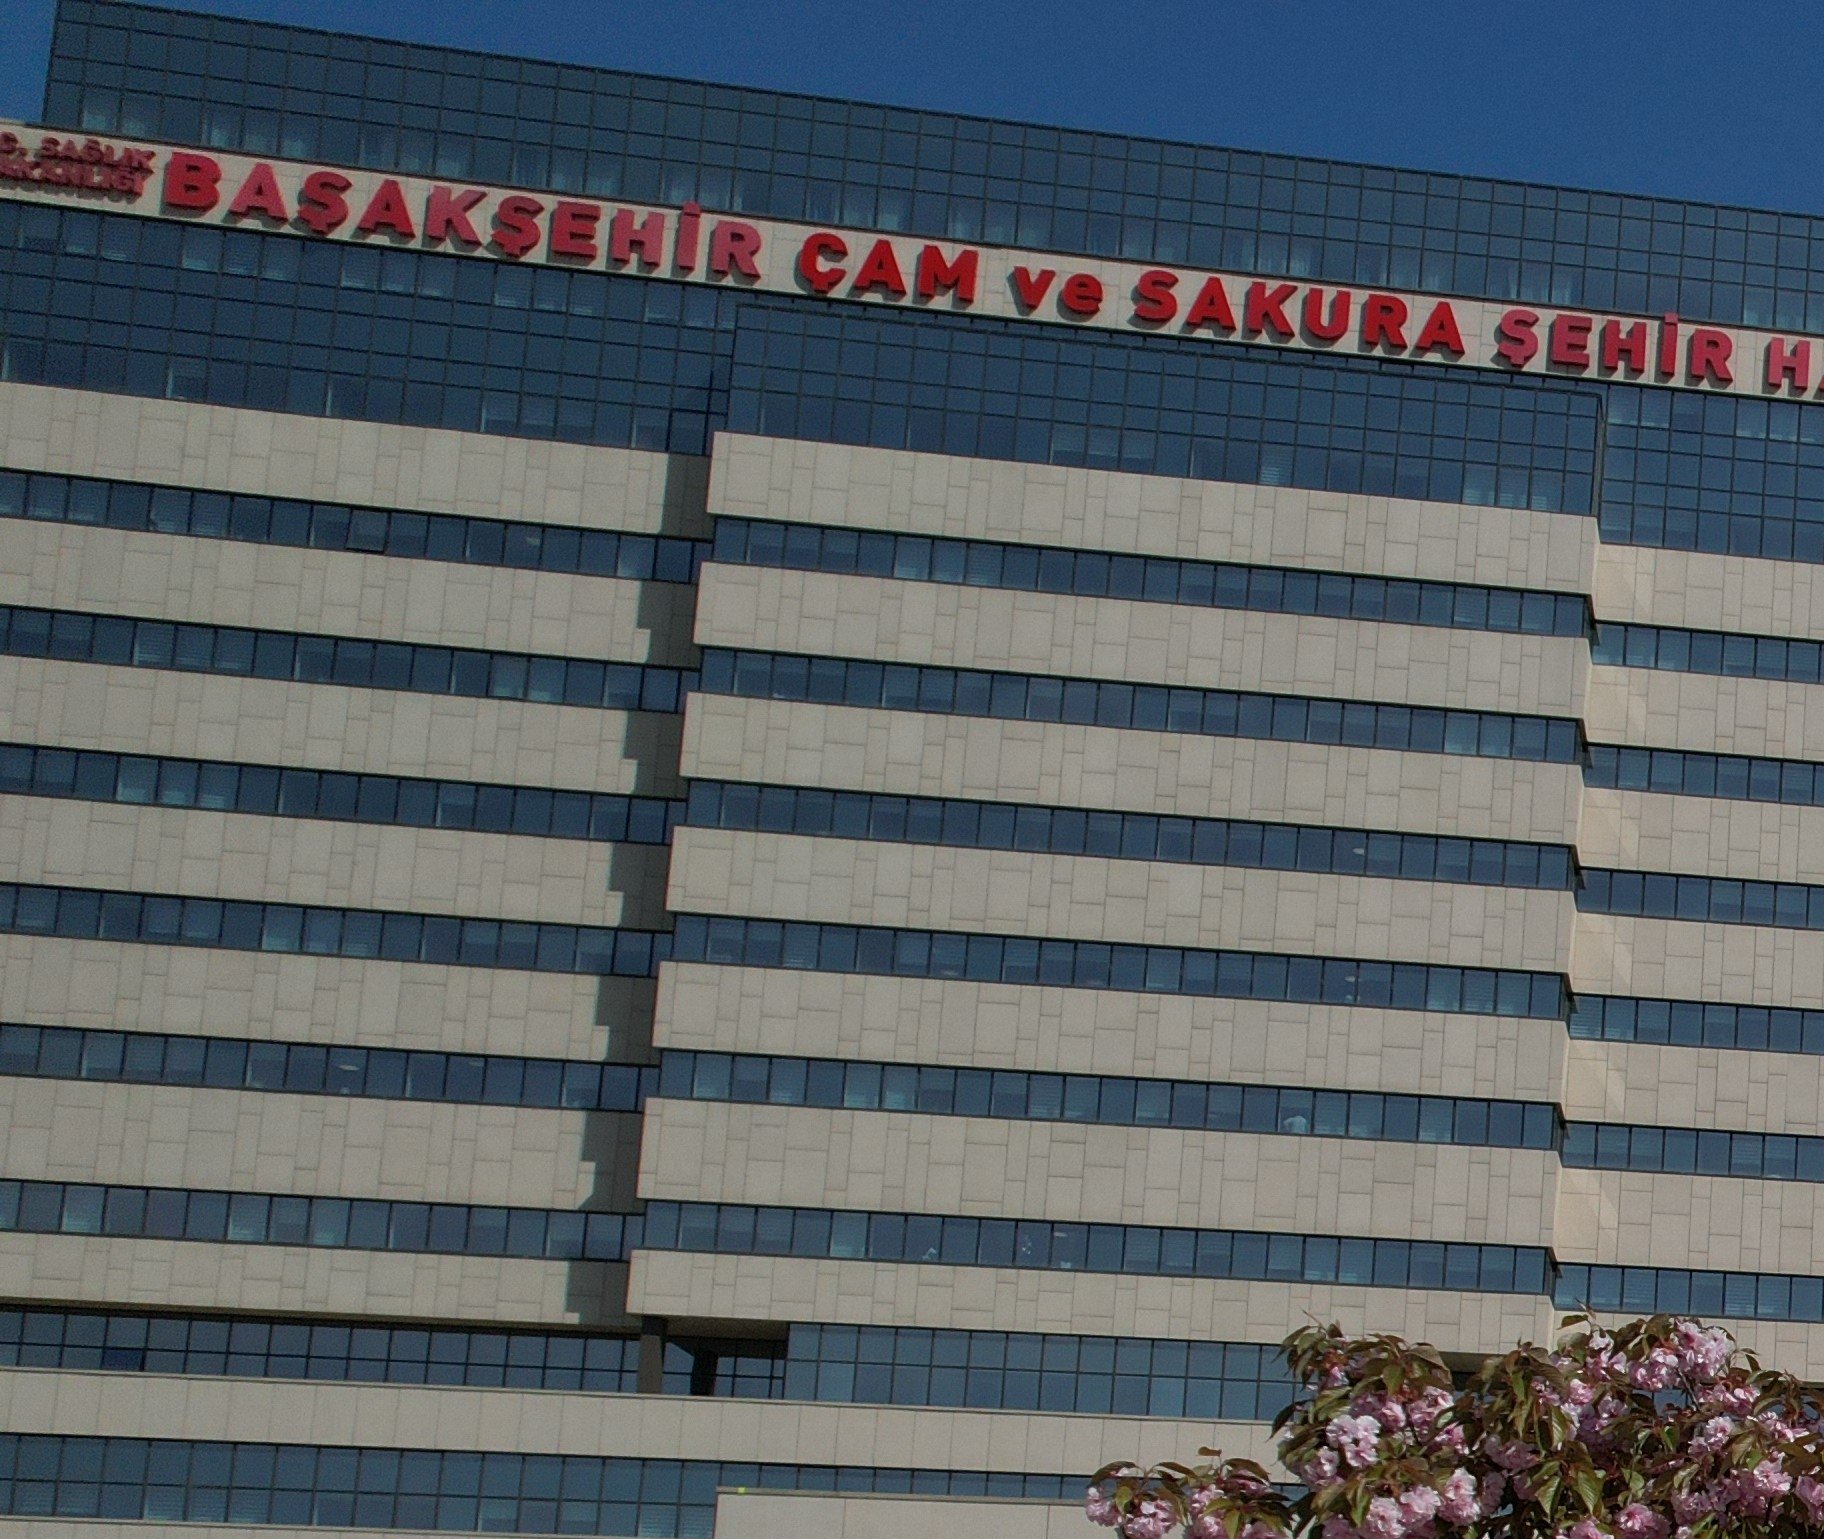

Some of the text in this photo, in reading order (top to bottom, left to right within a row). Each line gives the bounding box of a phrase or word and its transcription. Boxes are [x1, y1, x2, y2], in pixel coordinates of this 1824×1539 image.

[39, 136, 155, 174] SAĞLIK
[165, 151, 763, 277] BAŞAKŞEHİR
[799, 231, 981, 303] ÇAM
[1014, 266, 1106, 314] ve
[1134, 268, 1466, 354] SAKURA
[1497, 307, 1734, 382] ŞEHİR
